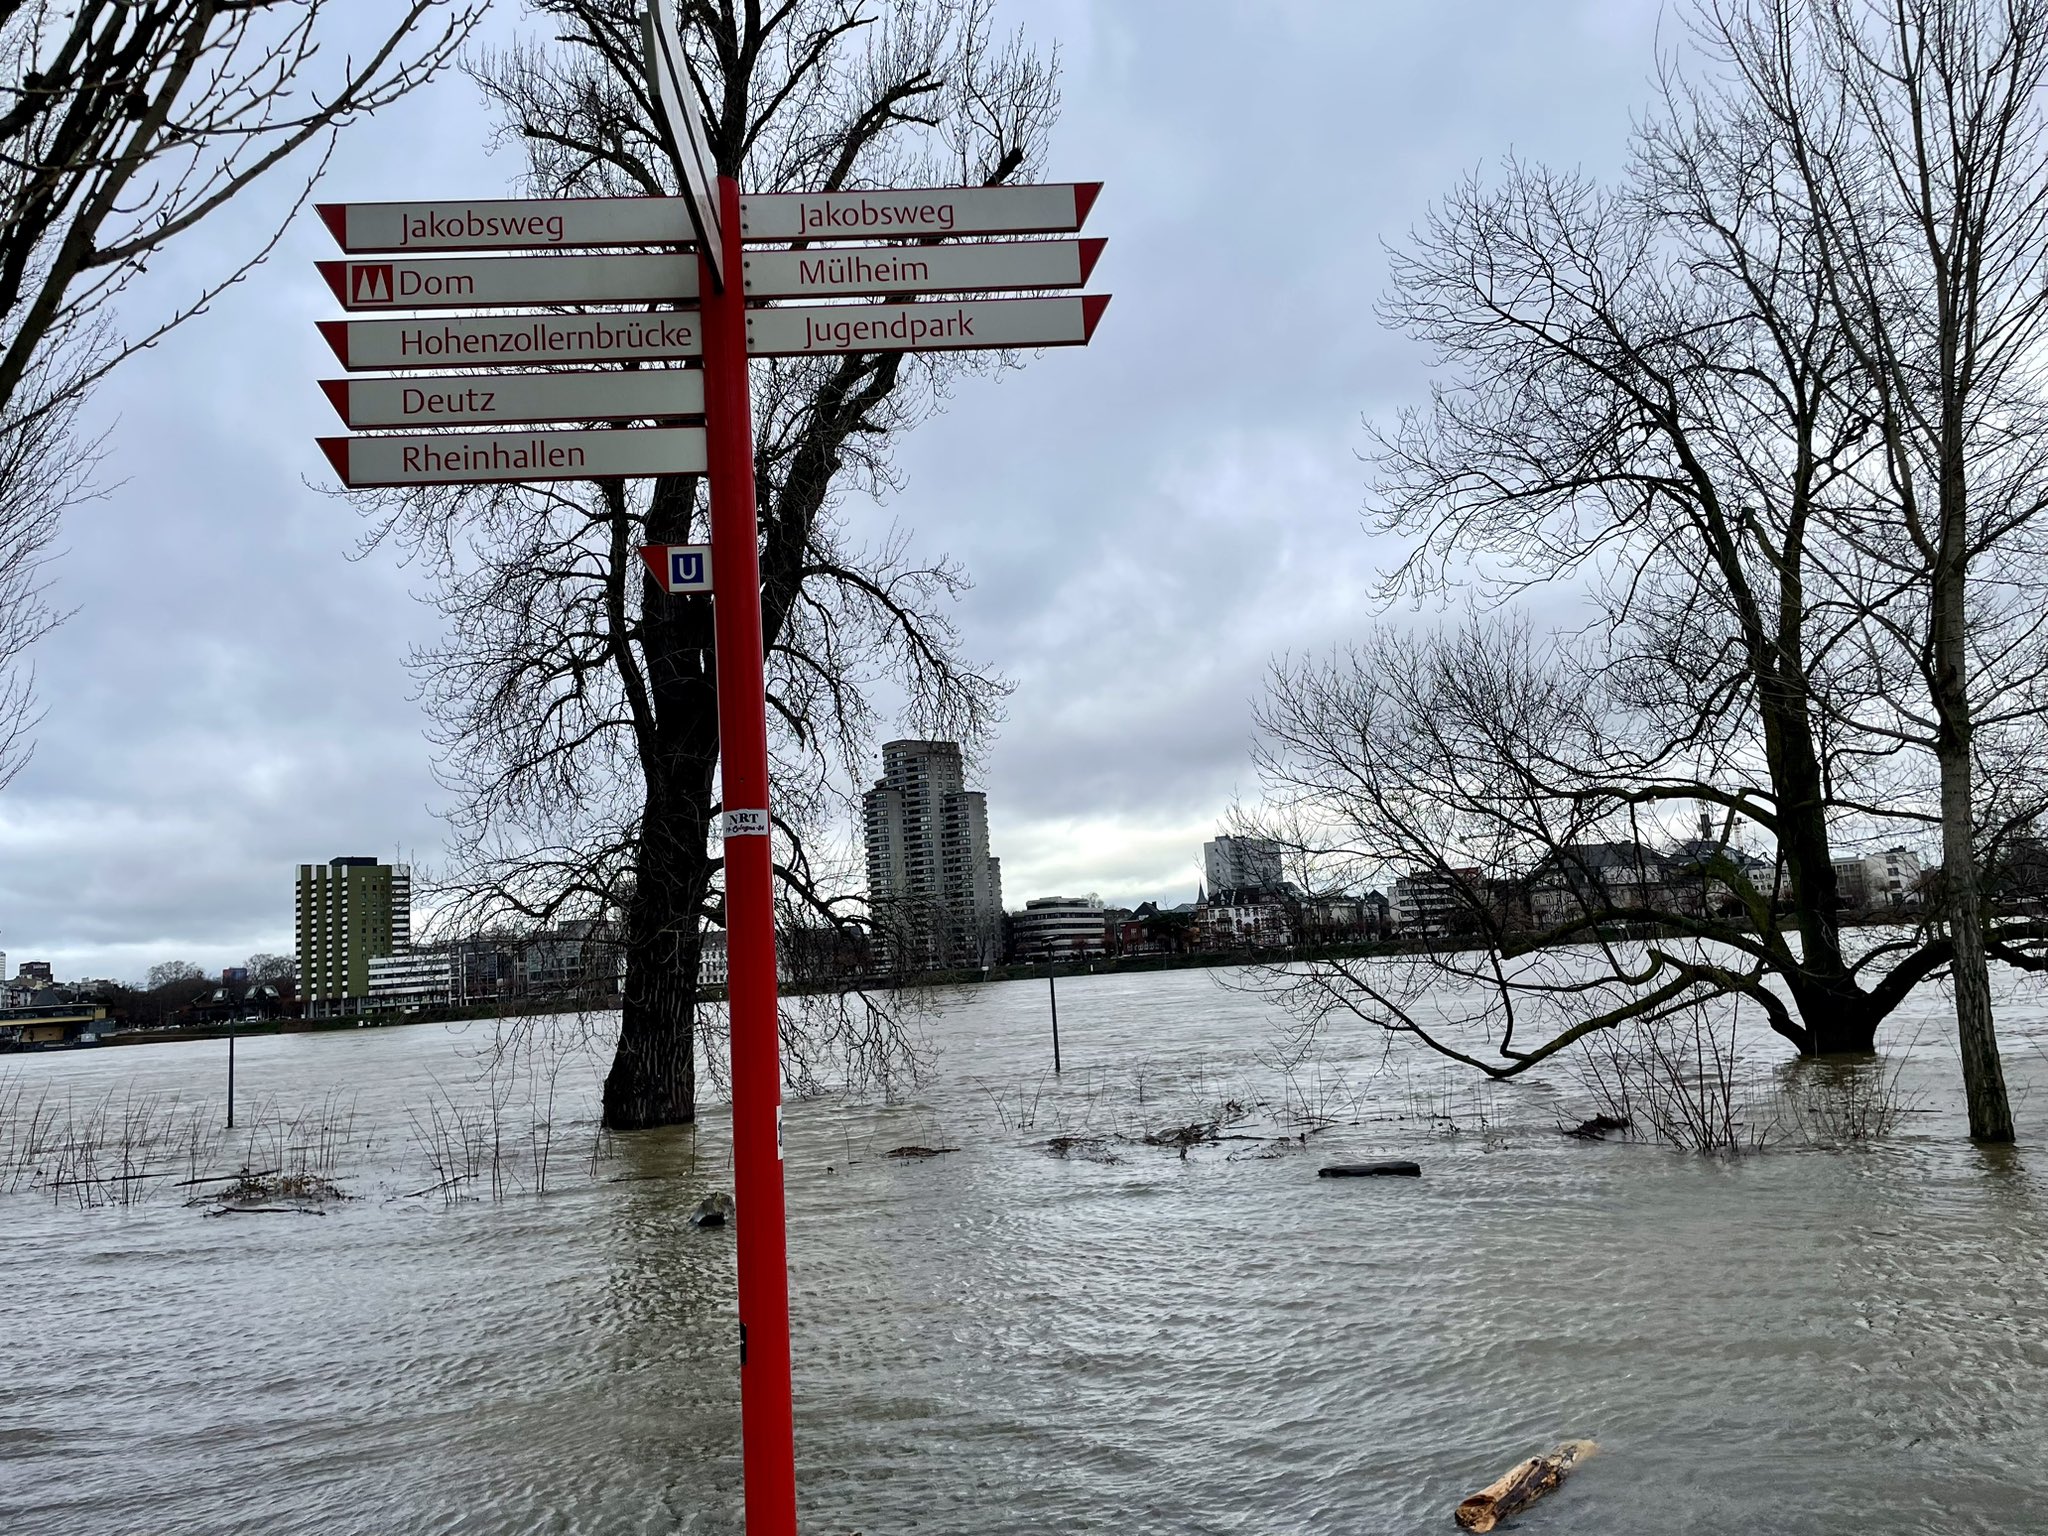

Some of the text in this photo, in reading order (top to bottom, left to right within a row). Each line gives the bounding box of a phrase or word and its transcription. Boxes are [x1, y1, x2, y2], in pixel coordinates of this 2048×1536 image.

[400, 210, 564, 243] Jakobsweg
[798, 199, 955, 234] Jakobsweg
[400, 270, 474, 296] Dom
[799, 255, 929, 285] Mülheim
[401, 320, 693, 356] Hohenzollernbrücke
[803, 309, 975, 349] Jugendpark
[402, 388, 497, 414] Deutz
[402, 440, 586, 473] Rheinhallen
[678, 557, 697, 580] U
